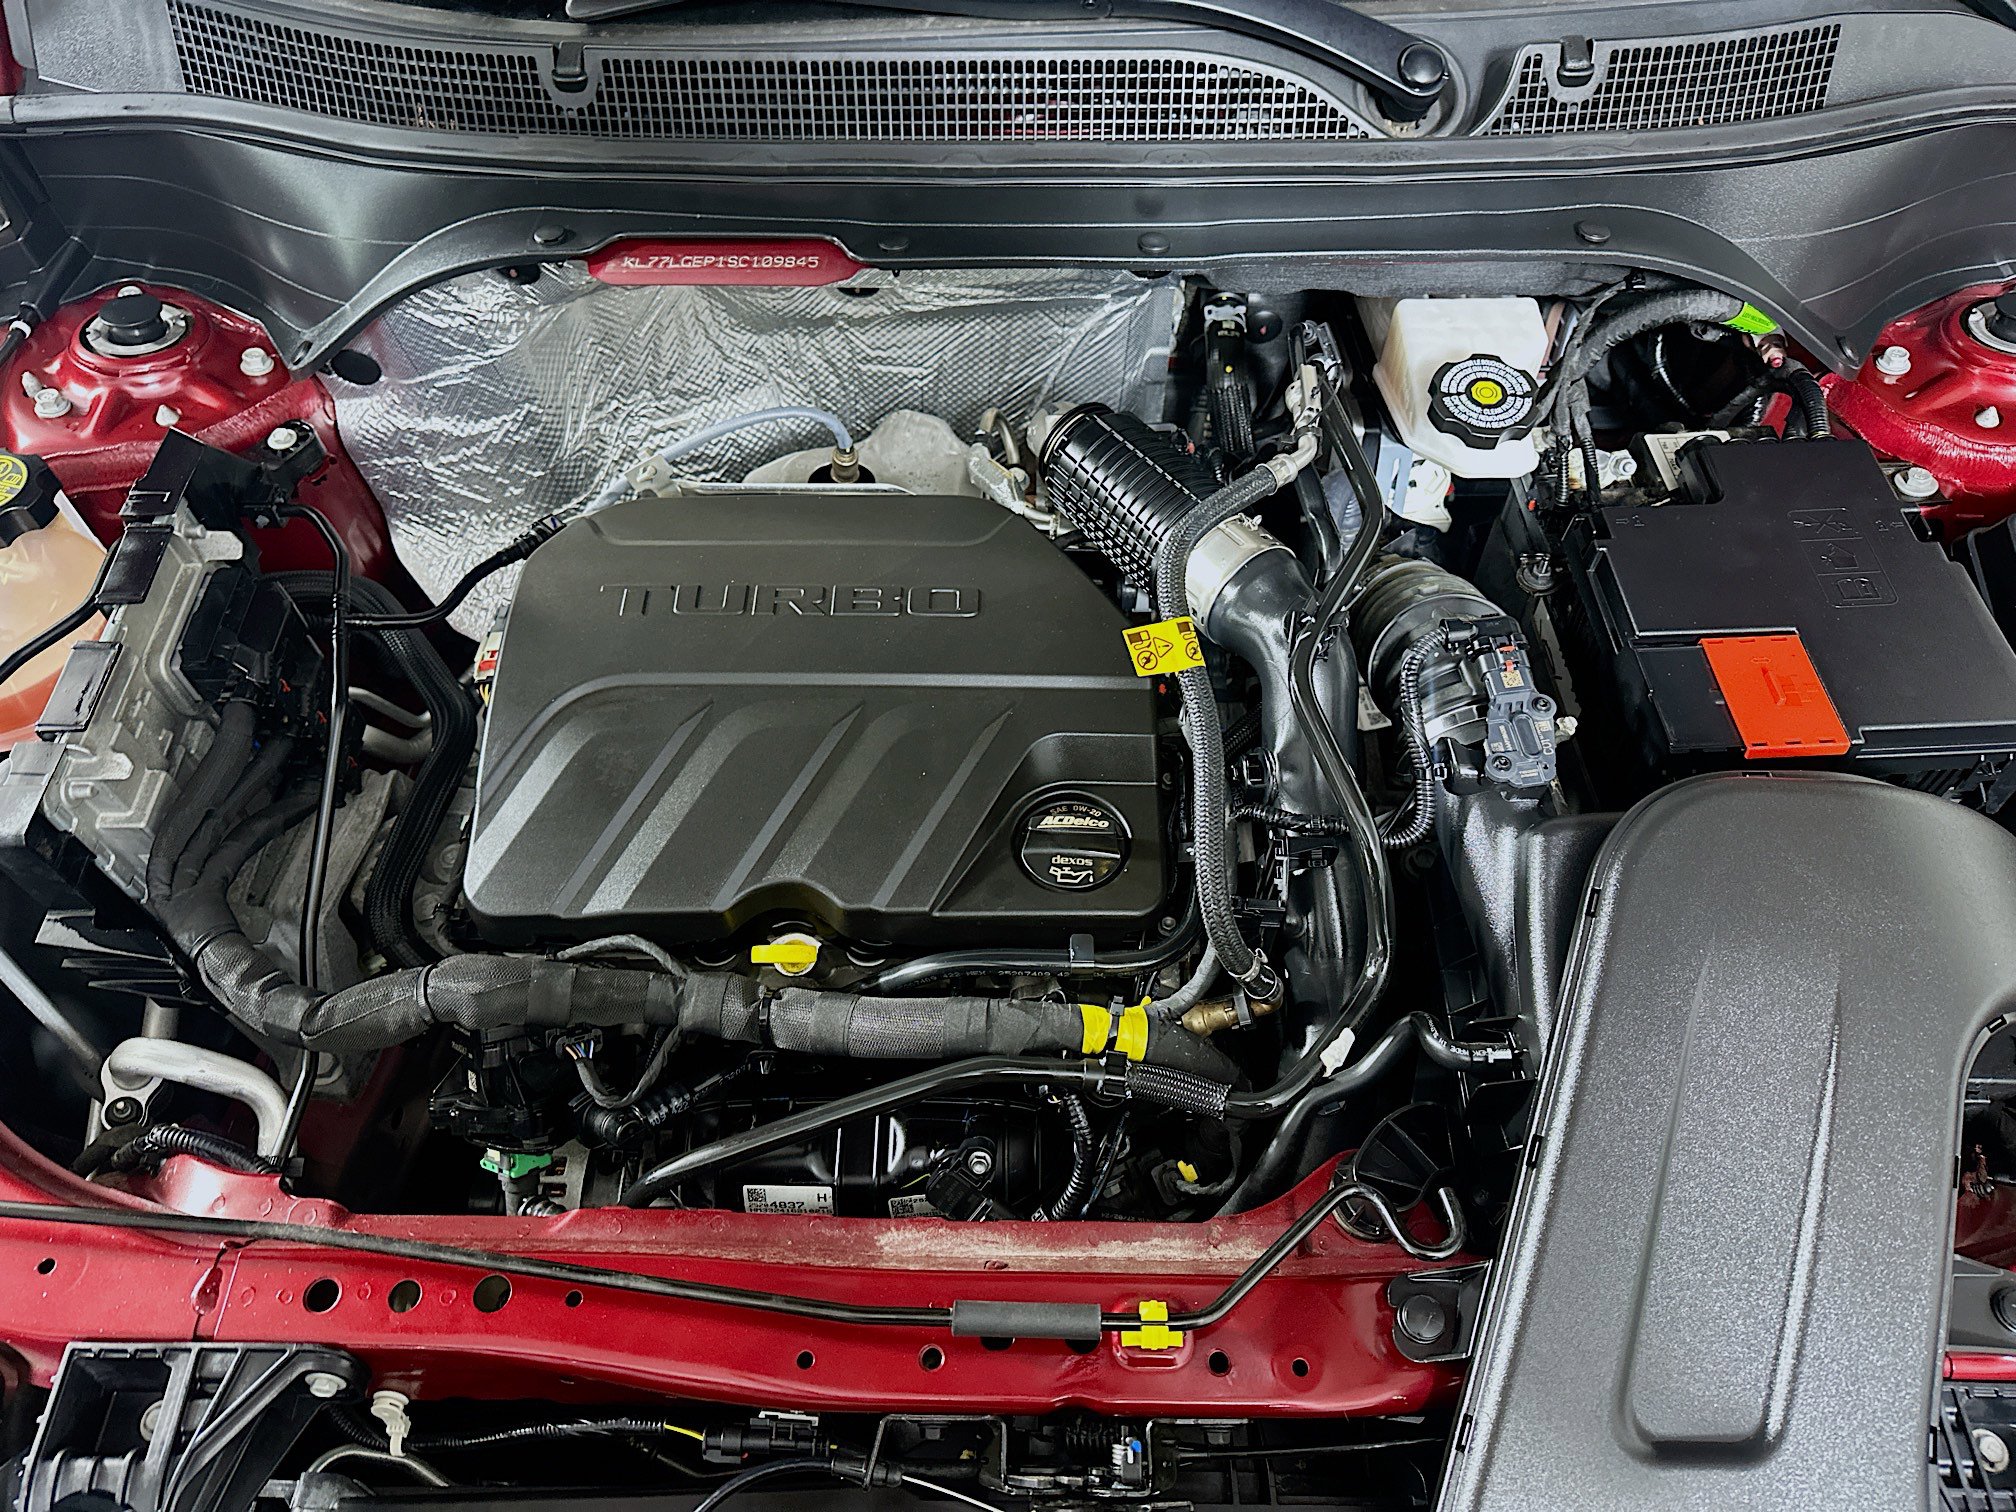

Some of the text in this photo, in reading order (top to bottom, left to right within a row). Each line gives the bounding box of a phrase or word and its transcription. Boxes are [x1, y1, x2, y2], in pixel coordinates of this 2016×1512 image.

[600, 583, 982, 617] TURBO
[1050, 805, 1068, 816] SAE
[1039, 815, 1110, 828] ACDelco
[1051, 854, 1094, 866] dexos
[816, 1192, 828, 1203] H
